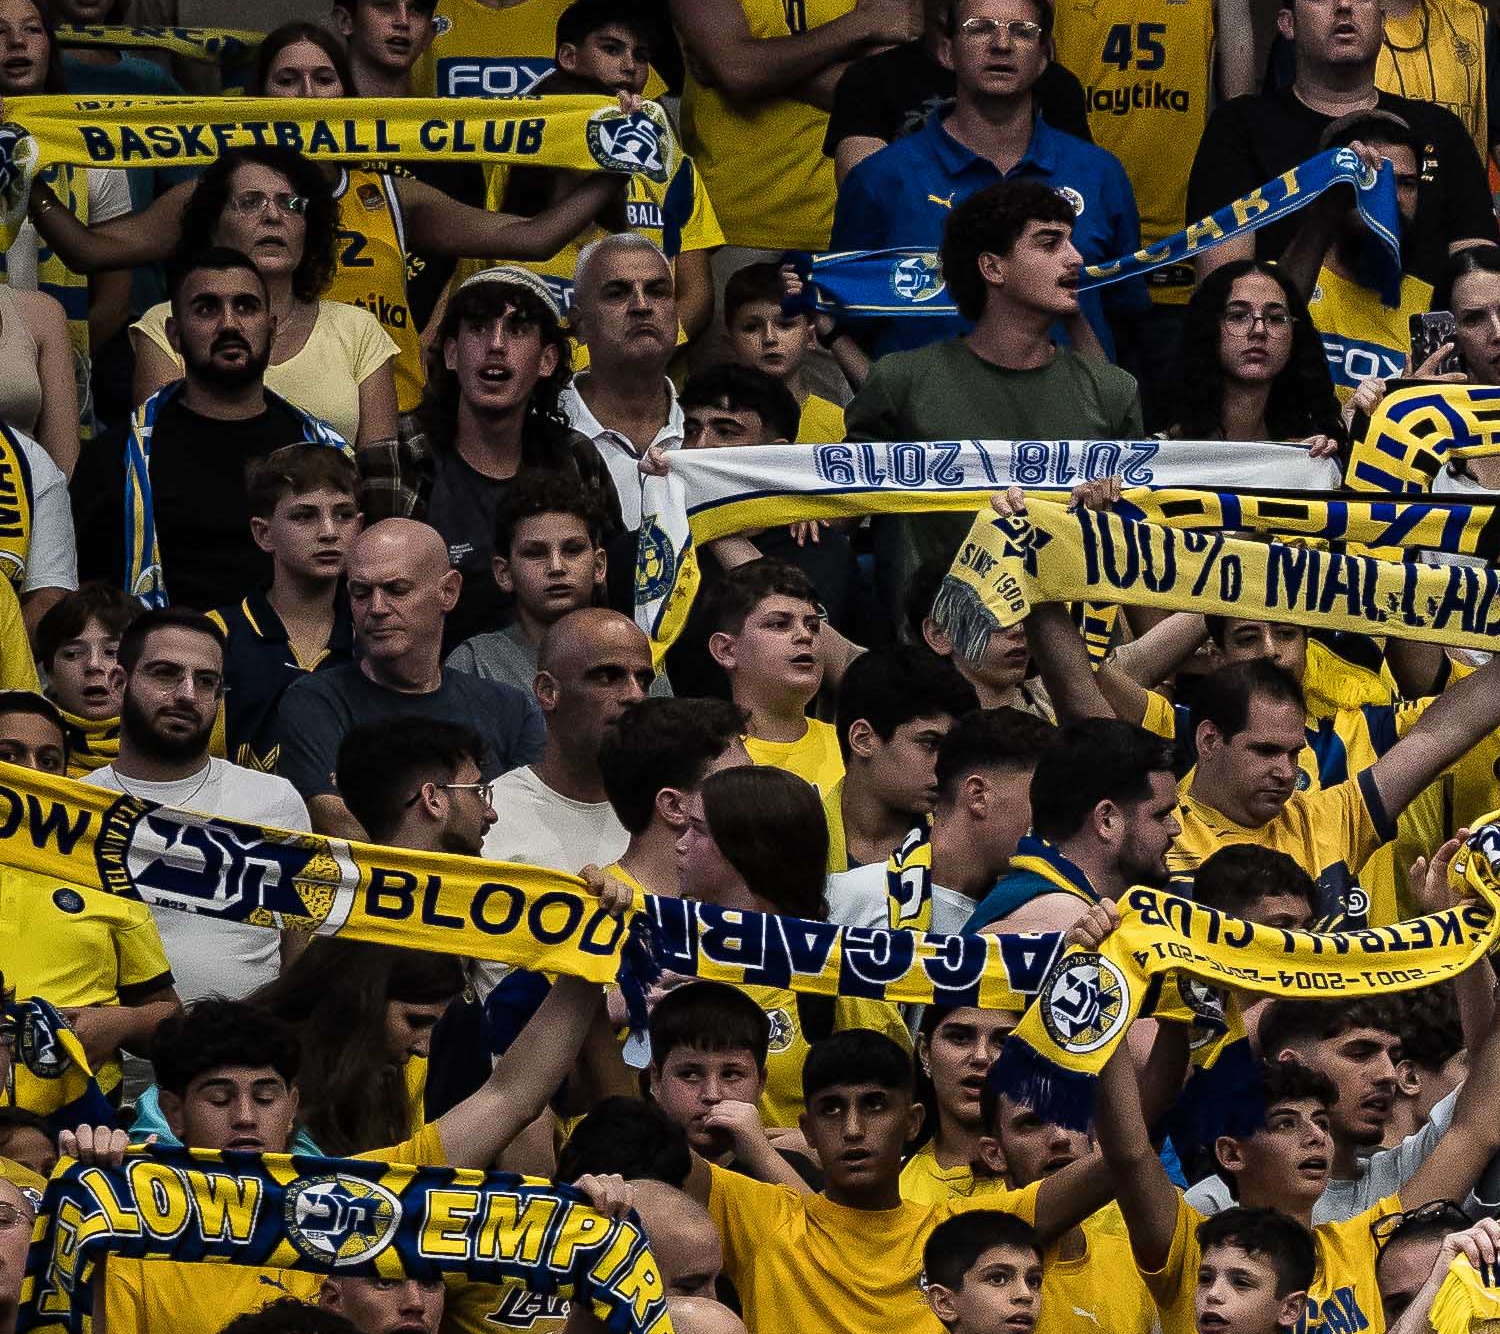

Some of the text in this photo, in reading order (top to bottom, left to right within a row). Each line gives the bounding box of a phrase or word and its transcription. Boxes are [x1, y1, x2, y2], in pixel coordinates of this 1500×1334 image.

[1101, 23, 1166, 72] 45
[447, 64, 559, 97] FOX
[1083, 83, 1190, 117] laytika
[79, 118, 545, 164] BASKETBALL CLUB
[813, 441, 1159, 489] 2018 2019
[1078, 507, 1243, 604] 100%
[366, 868, 629, 956] BLOOD
[1127, 893, 1250, 950] CLUB
